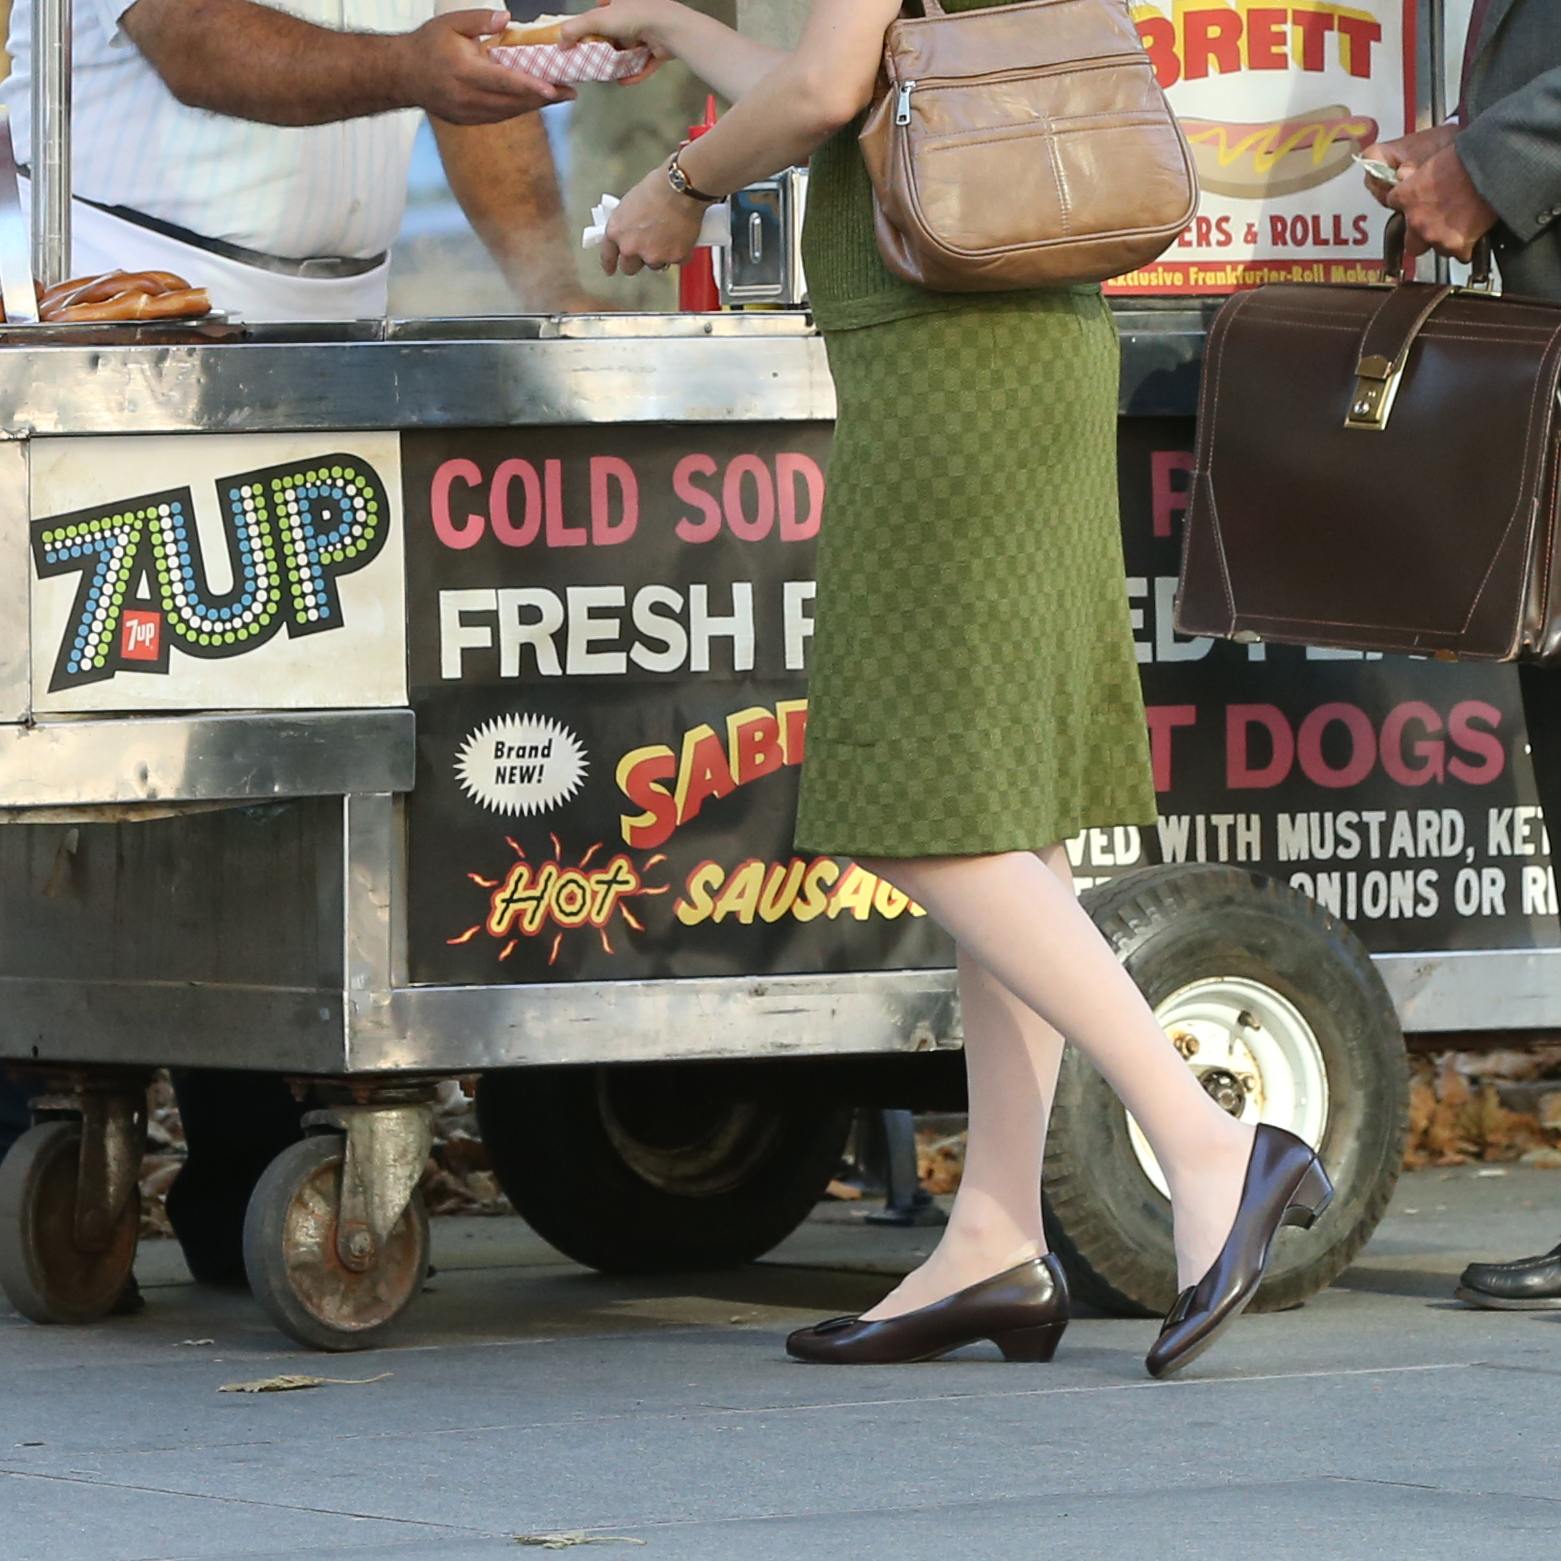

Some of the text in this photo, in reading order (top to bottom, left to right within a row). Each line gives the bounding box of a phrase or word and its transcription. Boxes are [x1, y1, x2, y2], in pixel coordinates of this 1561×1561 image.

[1269, 214, 1369, 246] ROLLS
[430, 452, 827, 550] COLD SOD
[28, 454, 389, 693] 7UP
[438, 581, 756, 680] FRESH
[493, 738, 553, 760] Brand
[494, 762, 545, 785] NEW!
[1225, 700, 1505, 790] DOGS
[1156, 814, 1262, 865] WITH
[1276, 808, 1476, 864] MUSTARD,
[674, 856, 928, 926] SAUSAG
[1454, 866, 1507, 917] OR
